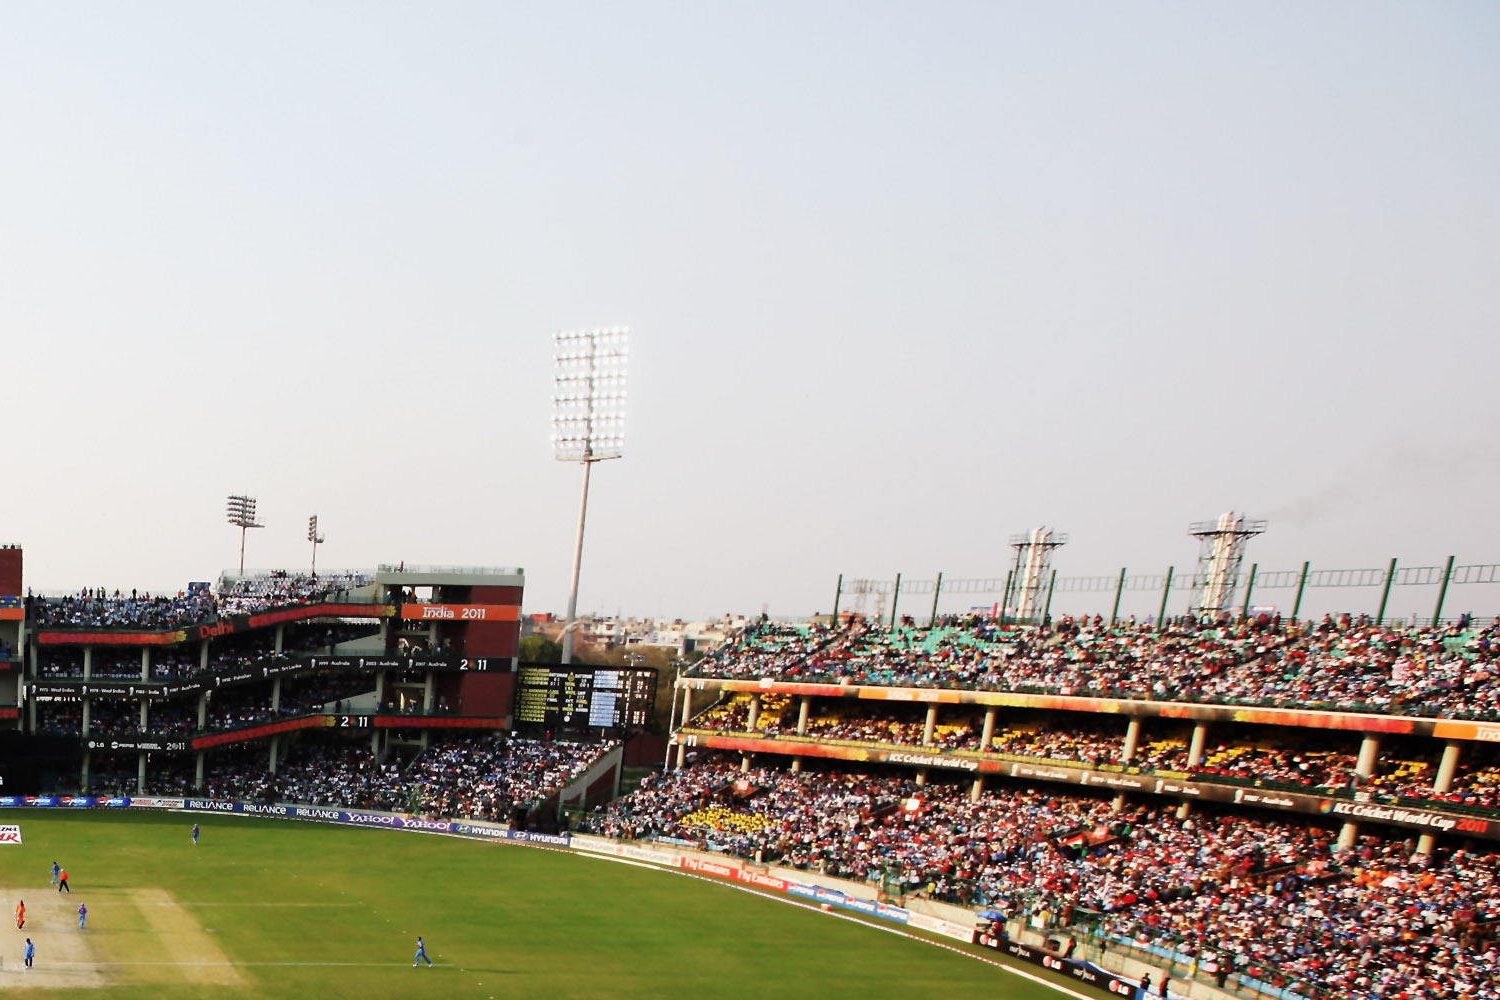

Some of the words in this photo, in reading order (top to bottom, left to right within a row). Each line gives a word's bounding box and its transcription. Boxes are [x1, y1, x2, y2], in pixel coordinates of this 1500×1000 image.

[422, 607, 454, 618] India
[461, 608, 486, 619] 2011
[200, 621, 235, 639] Delhi
[904, 754, 933, 766] Cricket
[933, 757, 958, 768] World
[958, 759, 978, 771] Cup
[345, 812, 395, 825] YAHOO!
[1333, 802, 1352, 815] ICC
[1352, 805, 1392, 820] Cricket
[1392, 809, 1430, 826] World
[1429, 812, 1456, 831] Cup
[1456, 817, 1489, 833] 2011
[400, 818, 451, 832] YAHOO!
[471, 826, 508, 838] HYUNDAI
[529, 833, 568, 845] HYUNDAI
[684, 857, 699, 871] Fly
[699, 861, 731, 876] Emirates
[737, 869, 753, 883] Fly
[752, 873, 784, 889] Emirates
[987, 937, 998, 948] LG
[1051, 959, 1063, 970] LG
[1117, 984, 1130, 996] LG
